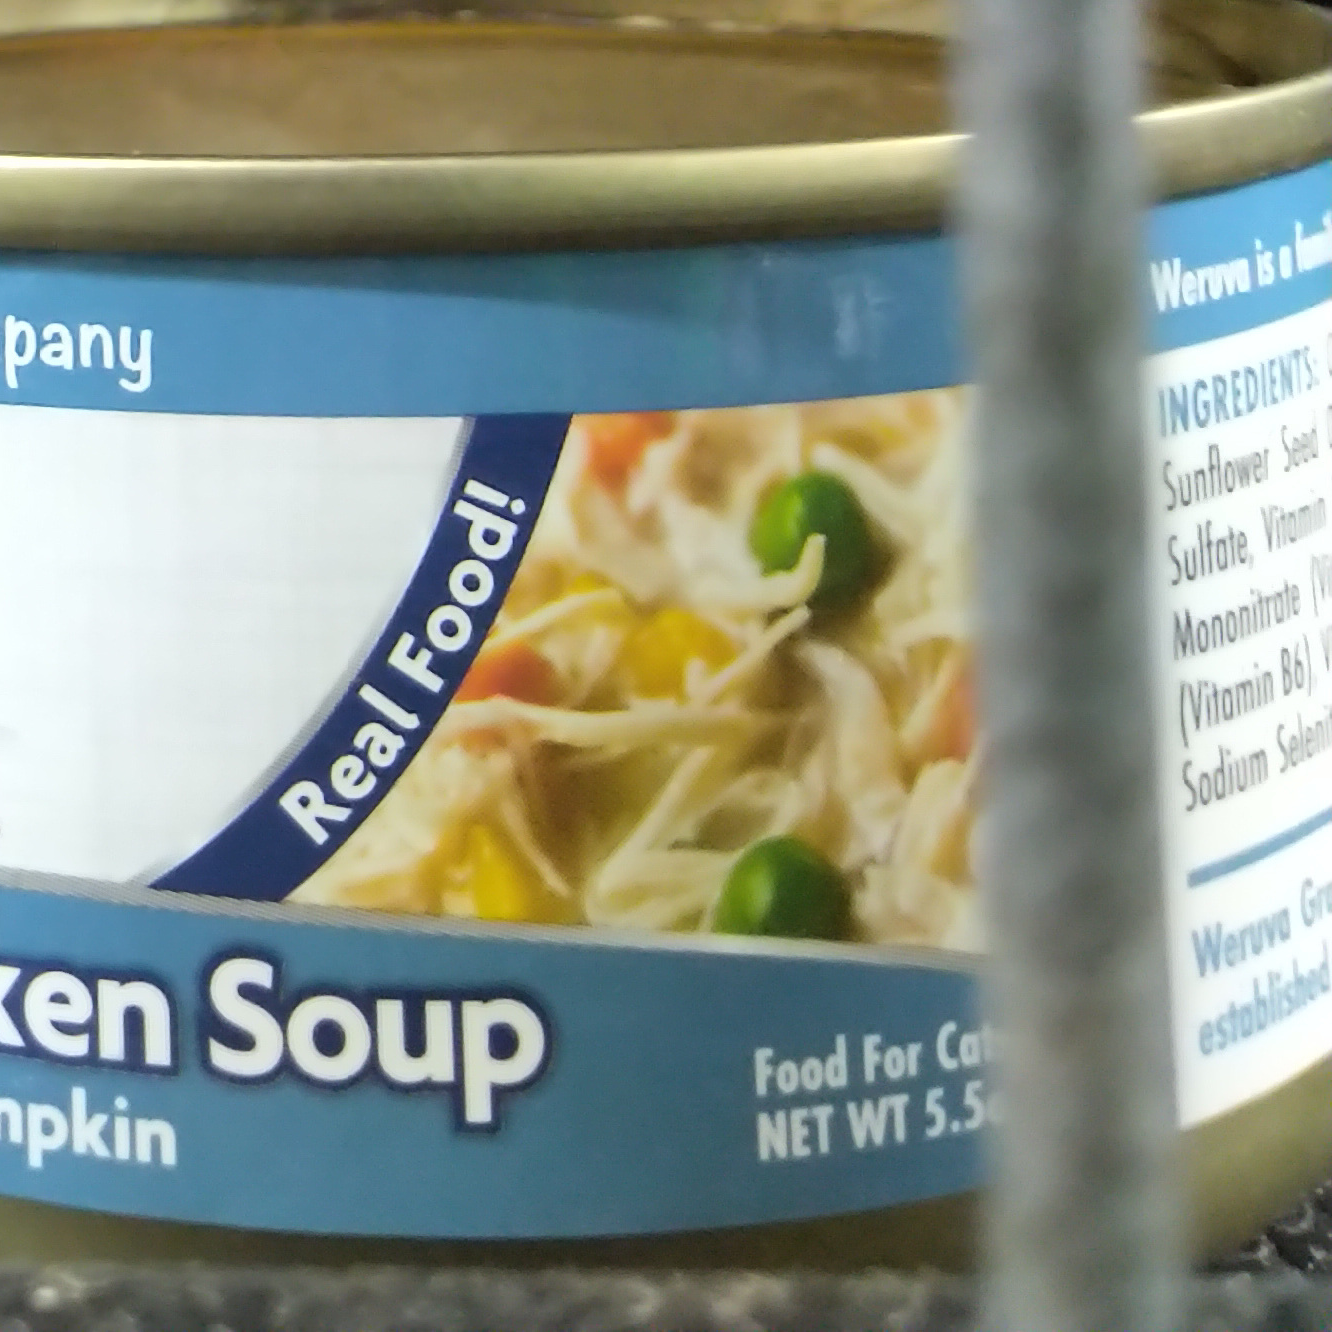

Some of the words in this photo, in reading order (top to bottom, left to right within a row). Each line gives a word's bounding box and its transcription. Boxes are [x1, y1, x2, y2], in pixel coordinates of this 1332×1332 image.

[1150, 258, 1250, 313] Weruva
[1254, 238, 1275, 287] is
[1163, 444, 1269, 511] Sunflower
[1168, 519, 1254, 586] Sulfate,
[1173, 579, 1301, 660] Mononitrate
[278, 684, 420, 845] Real
[388, 479, 526, 694] Food!
[1180, 662, 1274, 748] (Vitamin
[1182, 745, 1269, 812] Sodium
[1191, 906, 1291, 978] Weruva
[1199, 940, 1330, 1056] established
[209, 957, 545, 1123] Soup
[754, 1033, 848, 1097] Food
[863, 1034, 922, 1084] For
[758, 1104, 834, 1162] NET
[847, 1093, 911, 1150] WT
